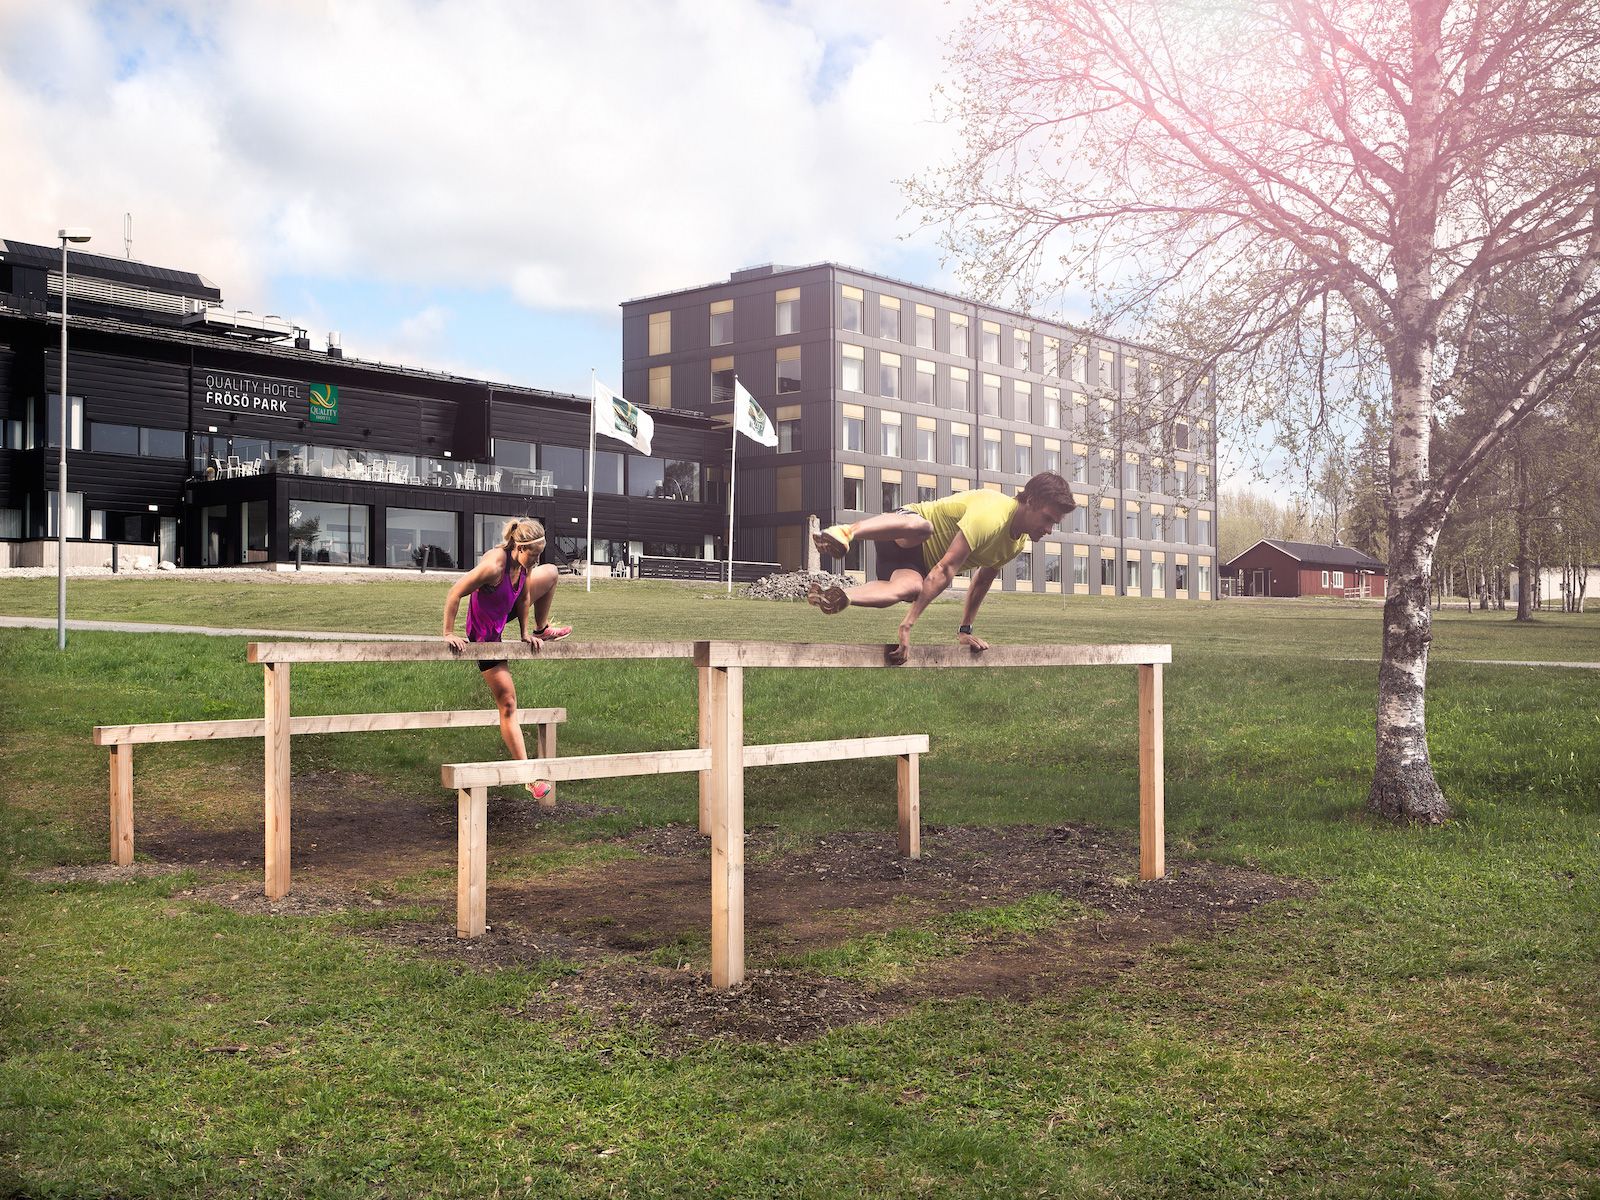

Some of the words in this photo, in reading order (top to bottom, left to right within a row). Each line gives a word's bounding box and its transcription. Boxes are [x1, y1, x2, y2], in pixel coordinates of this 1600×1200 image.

[206, 375, 259, 393] QUALITY
[263, 382, 301, 399] HOTEL
[206, 391, 249, 408] FRÖSÖ
[253, 397, 287, 412] PARK
[310, 406, 337, 416] QUALITY
